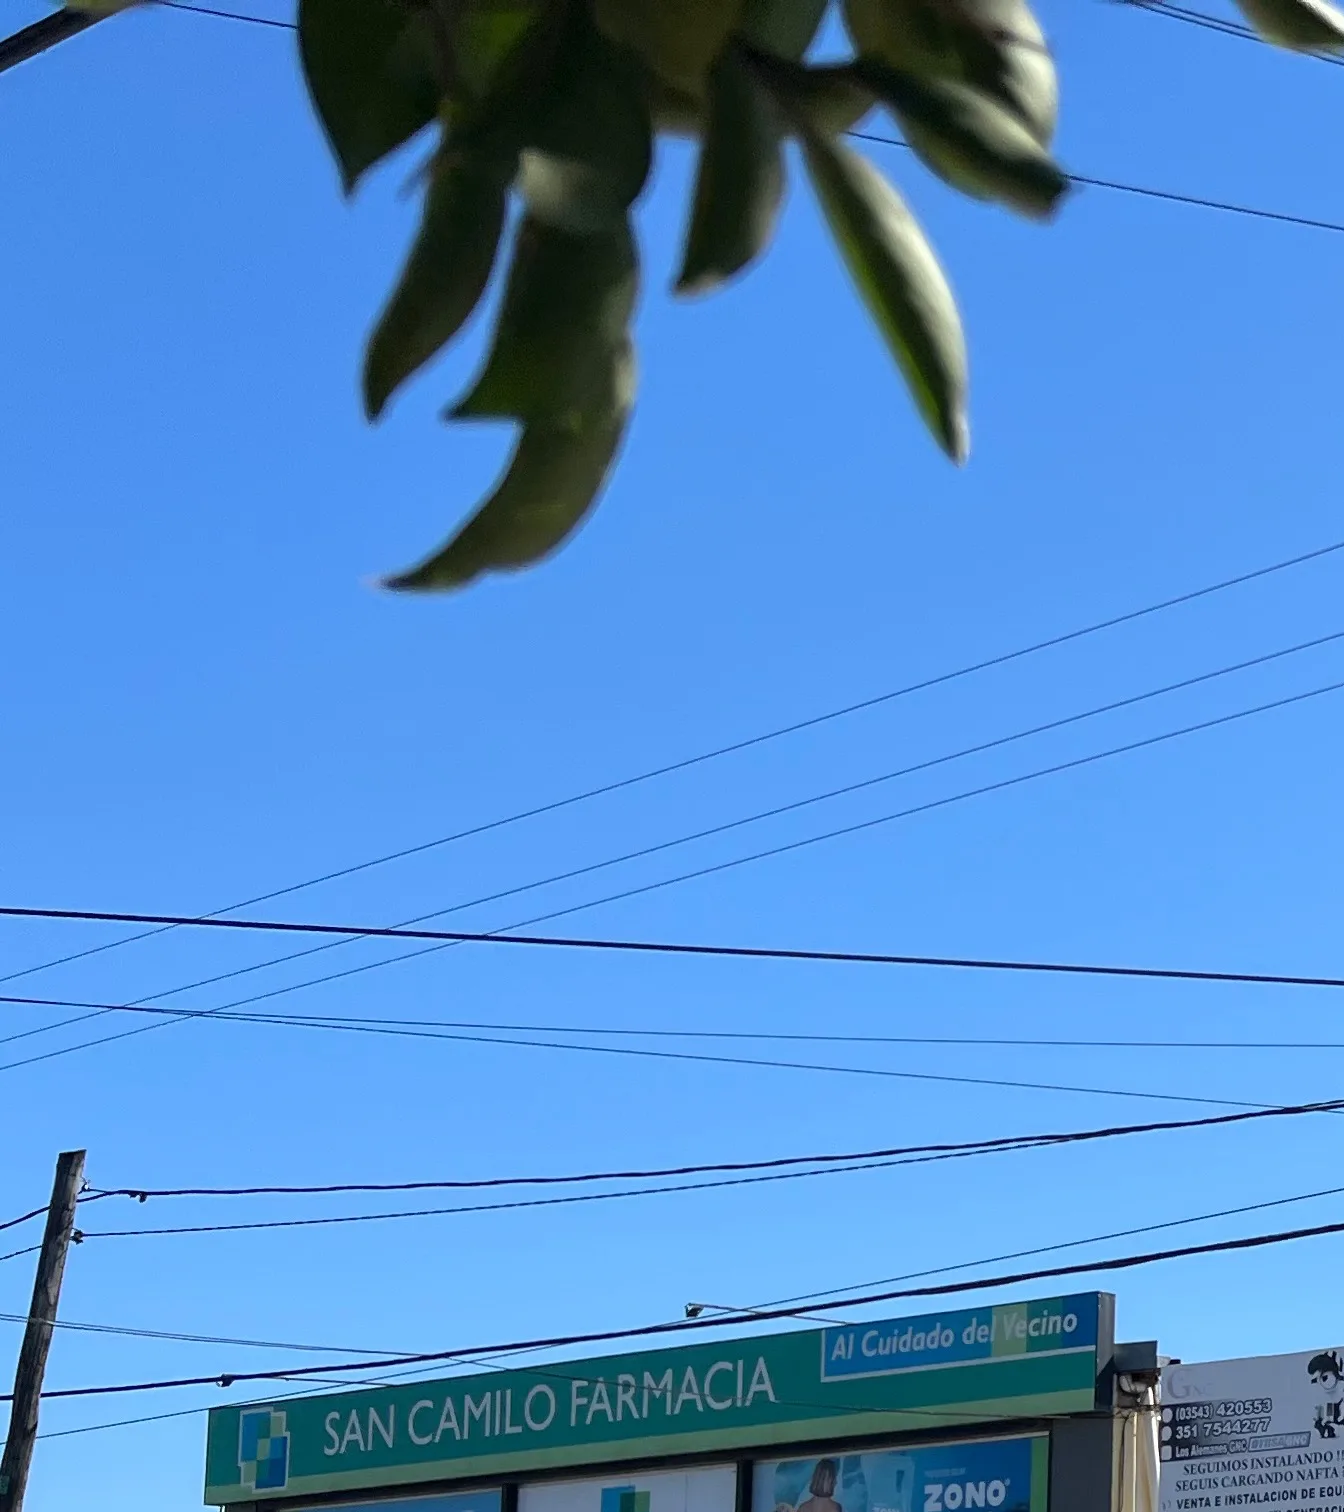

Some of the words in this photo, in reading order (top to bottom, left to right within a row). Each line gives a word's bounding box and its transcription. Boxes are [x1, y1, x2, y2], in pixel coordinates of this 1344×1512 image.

[832, 1332, 853, 1360] Al
[861, 1320, 955, 1356] Cuidado
[963, 1318, 996, 1346] del
[1002, 1312, 1078, 1340] Vecino
[323, 1405, 395, 1456] SAN
[408, 1385, 556, 1446] CAMILO
[570, 1357, 777, 1427] FARMACIA
[1216, 1399, 1273, 1416] 420553
[1175, 1425, 1198, 1440] 351
[1203, 1417, 1271, 1437] 7544277
[1175, 1445, 1189, 1458] Los
[1183, 1459, 1248, 1475] SEGUIMOS
[1250, 1451, 1333, 1471] INSTALANDO
[1175, 1476, 1219, 1492] SEGUIS
[1221, 1471, 1294, 1489] CARGANDO
[1296, 1467, 1339, 1482] NAFTA
[924, 1480, 1006, 1512] ZONO
[1176, 1496, 1212, 1510] VENTA
[1214, 1494, 1221, 1507] E
[1224, 1489, 1297, 1506] INSTALACION
[1301, 1487, 1316, 1499] DE
